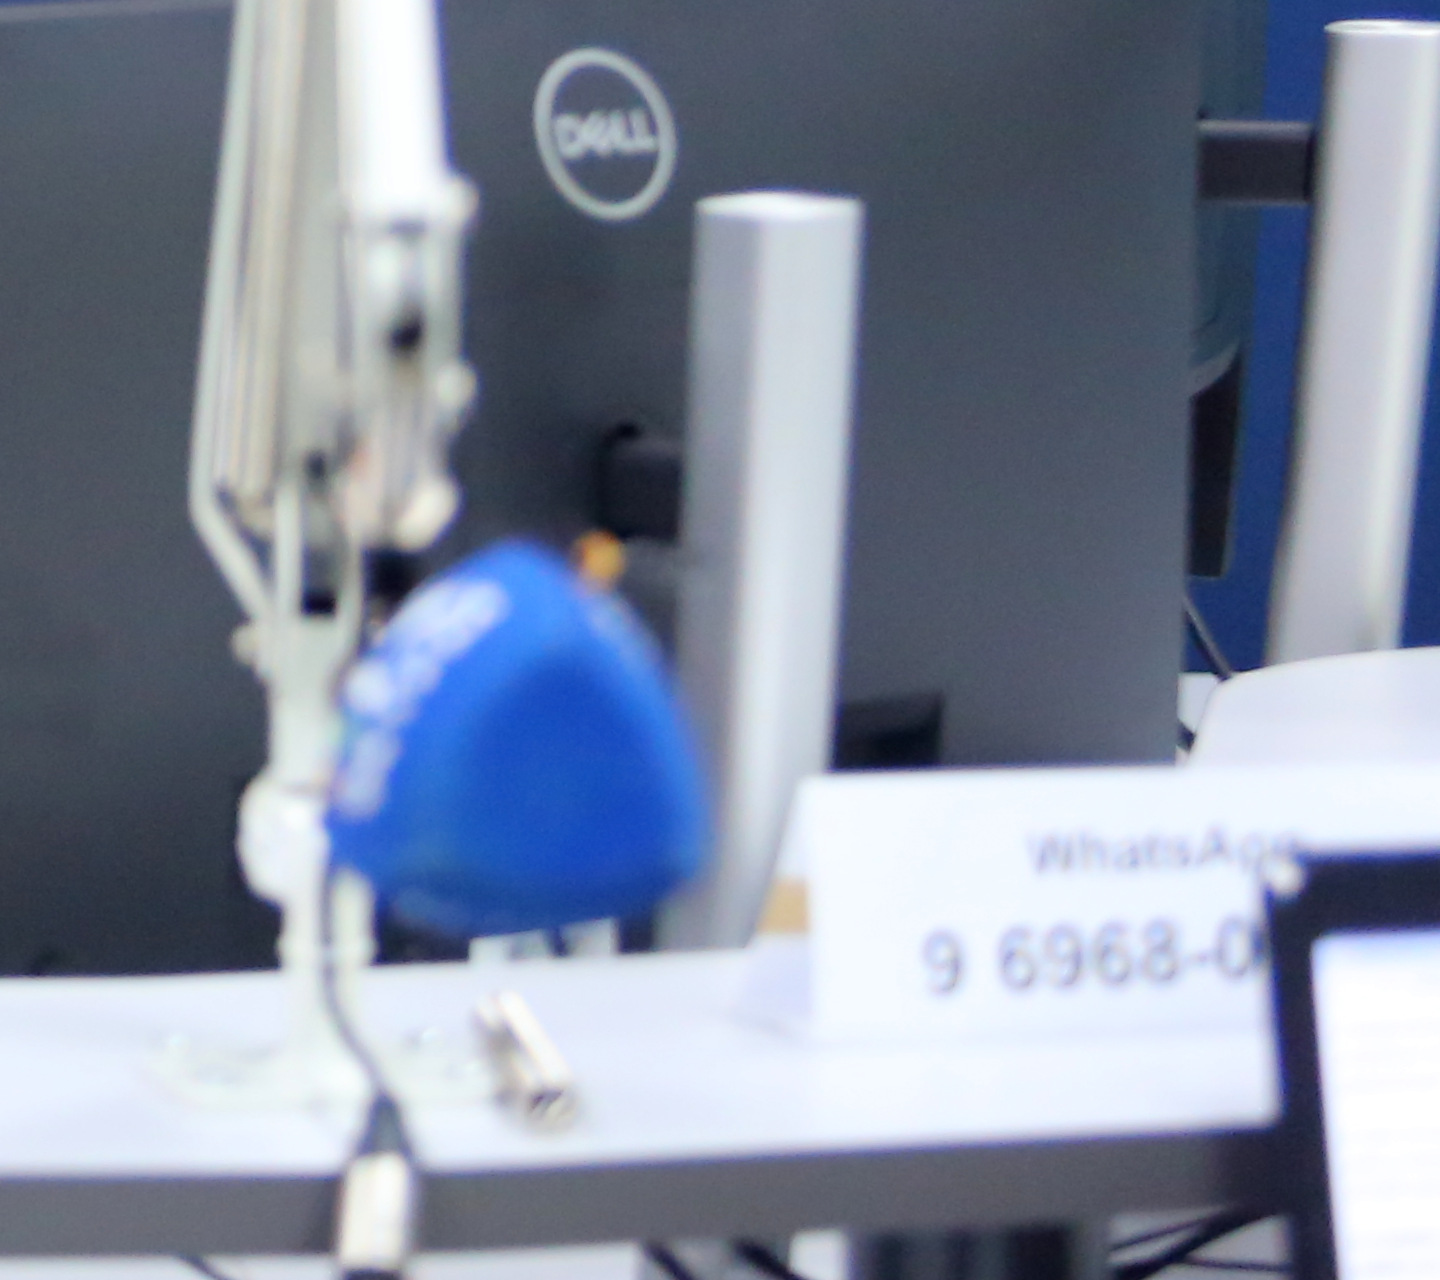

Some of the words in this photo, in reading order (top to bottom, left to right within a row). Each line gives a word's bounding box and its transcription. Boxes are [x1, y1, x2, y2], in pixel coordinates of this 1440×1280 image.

[553, 108, 658, 161] DELL
[921, 926, 964, 998] 9
[996, 913, 1262, 993] 6968-0
